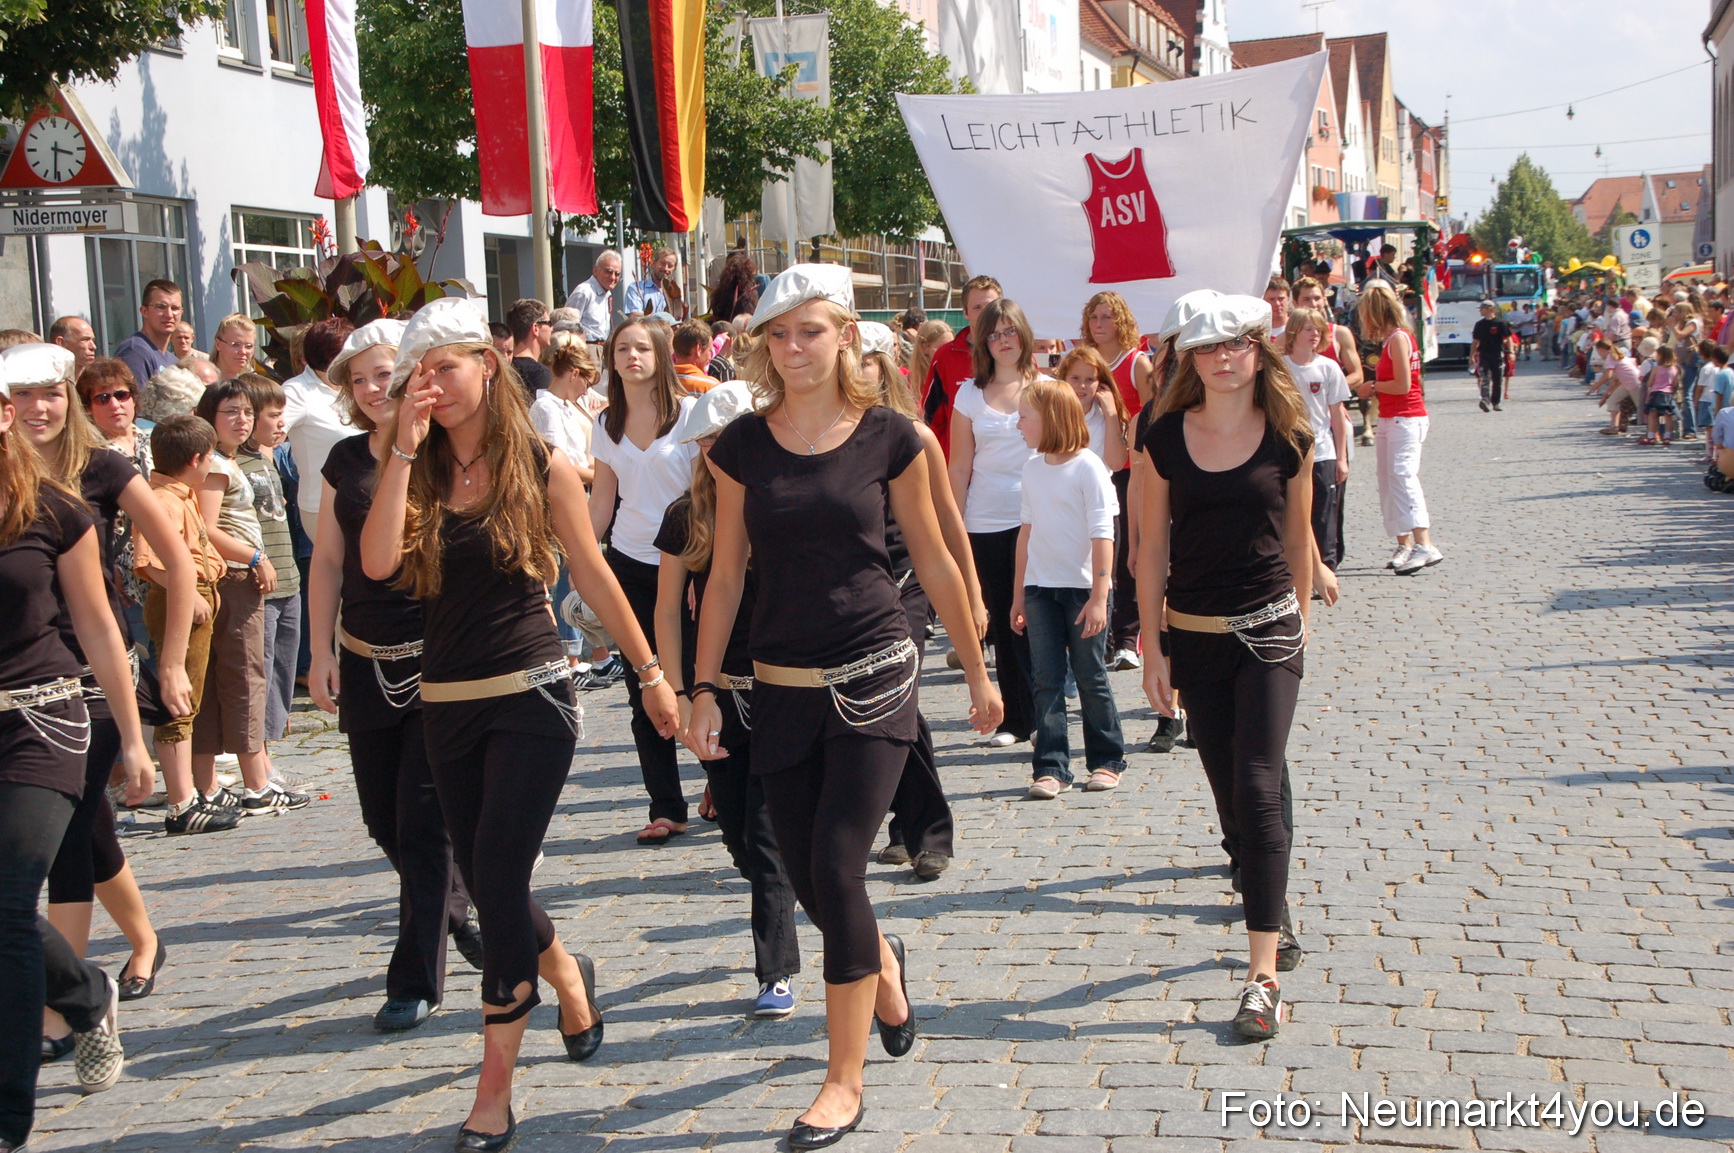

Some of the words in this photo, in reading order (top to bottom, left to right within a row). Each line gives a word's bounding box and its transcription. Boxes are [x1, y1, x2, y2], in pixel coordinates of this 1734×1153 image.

[940, 97, 1258, 151] LEICHTATHLETIK
[13, 209, 108, 229] Nidermayer
[1101, 190, 1146, 228] ASV
[1630, 251, 1652, 261] ZONE
